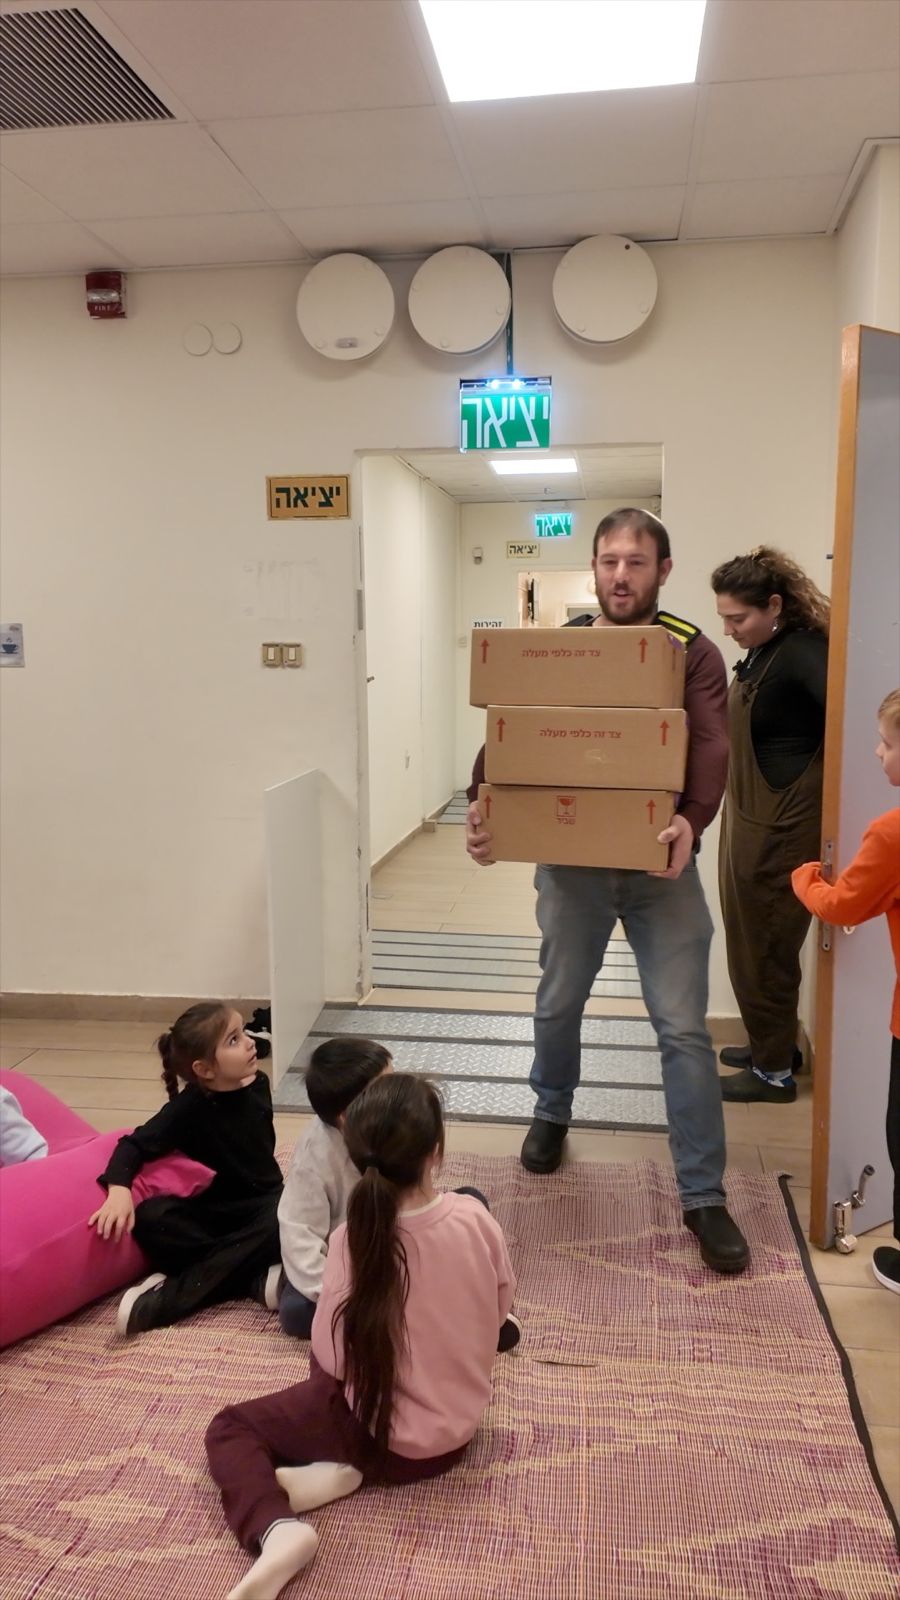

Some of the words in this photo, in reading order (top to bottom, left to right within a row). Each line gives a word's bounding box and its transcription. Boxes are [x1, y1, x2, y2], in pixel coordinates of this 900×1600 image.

[462, 395, 549, 448] יציאה
[275, 486, 341, 508] יציאה
[536, 515, 571, 536] יציאה
[509, 545, 537, 554] יציאה
[521, 648, 549, 658] מעלה
[551, 648, 572, 657] כלפי
[574, 649, 586, 657] זה
[588, 649, 601, 657] צד
[539, 727, 567, 738] מעלה
[569, 728, 592, 738] כלפי
[593, 730, 605, 738] זה
[607, 730, 622, 739] צד
